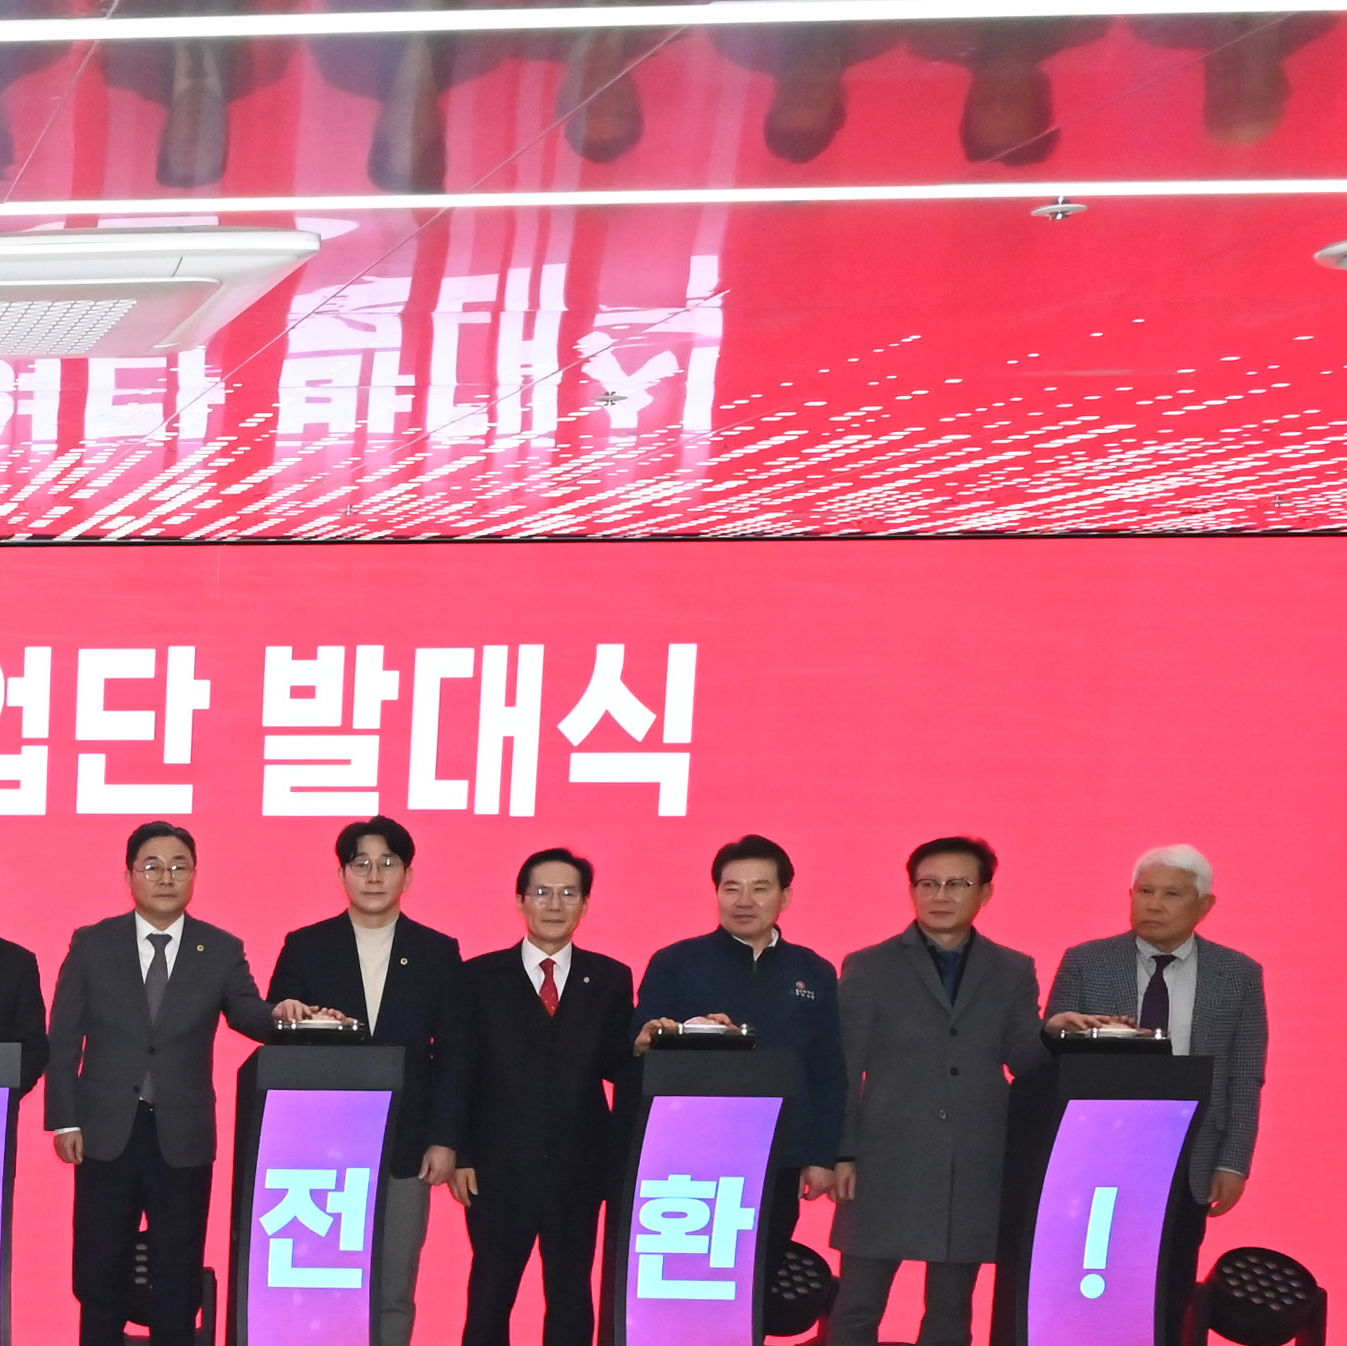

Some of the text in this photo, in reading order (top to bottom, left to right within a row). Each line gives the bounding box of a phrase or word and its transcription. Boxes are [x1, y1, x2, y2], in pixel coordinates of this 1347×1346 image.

[262, 643, 698, 817] 발대식
[259, 1167, 371, 1289] 전
[635, 1174, 756, 1301] 환
